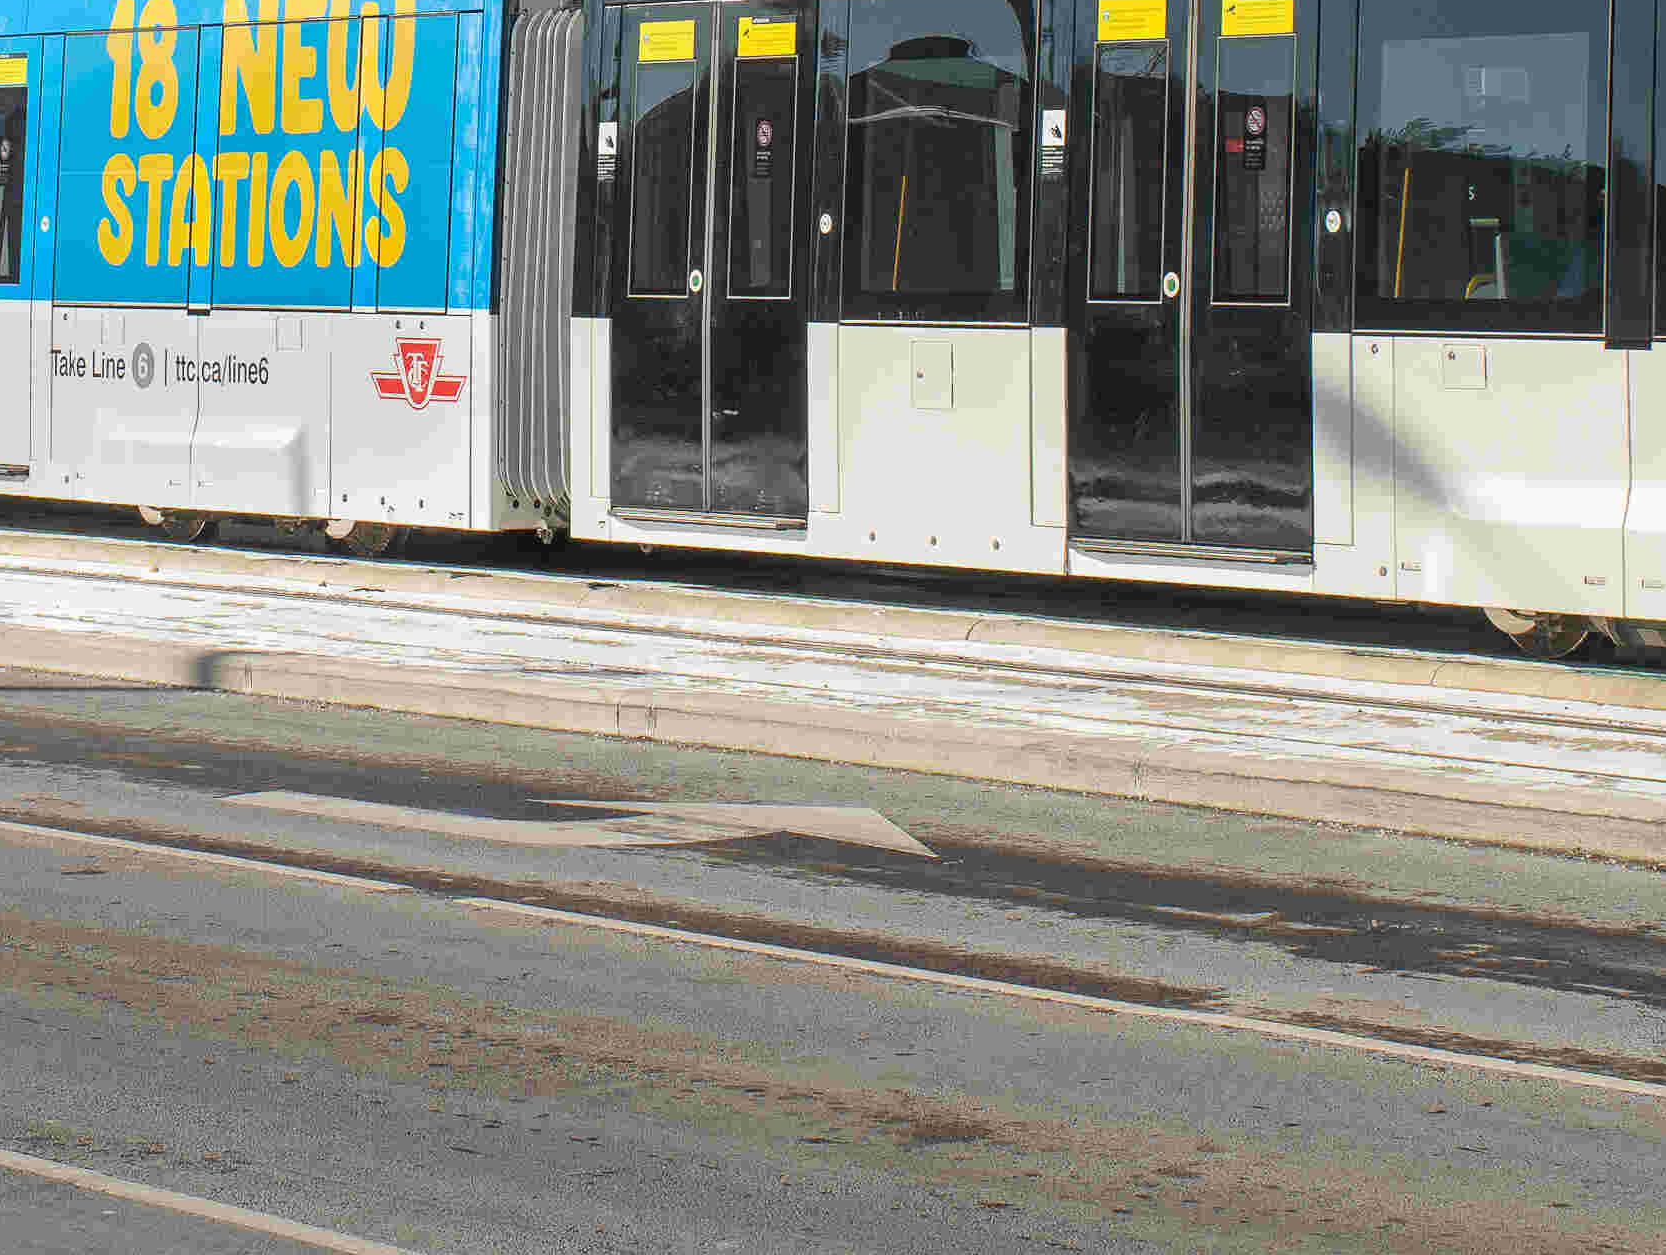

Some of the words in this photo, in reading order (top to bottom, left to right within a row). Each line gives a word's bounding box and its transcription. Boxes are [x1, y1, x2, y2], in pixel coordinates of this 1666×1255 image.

[97, 146, 411, 269] STATIONS
[50, 346, 87, 377] Take
[92, 347, 127, 379] Line
[175, 352, 270, 386] ttc.ca/line6
